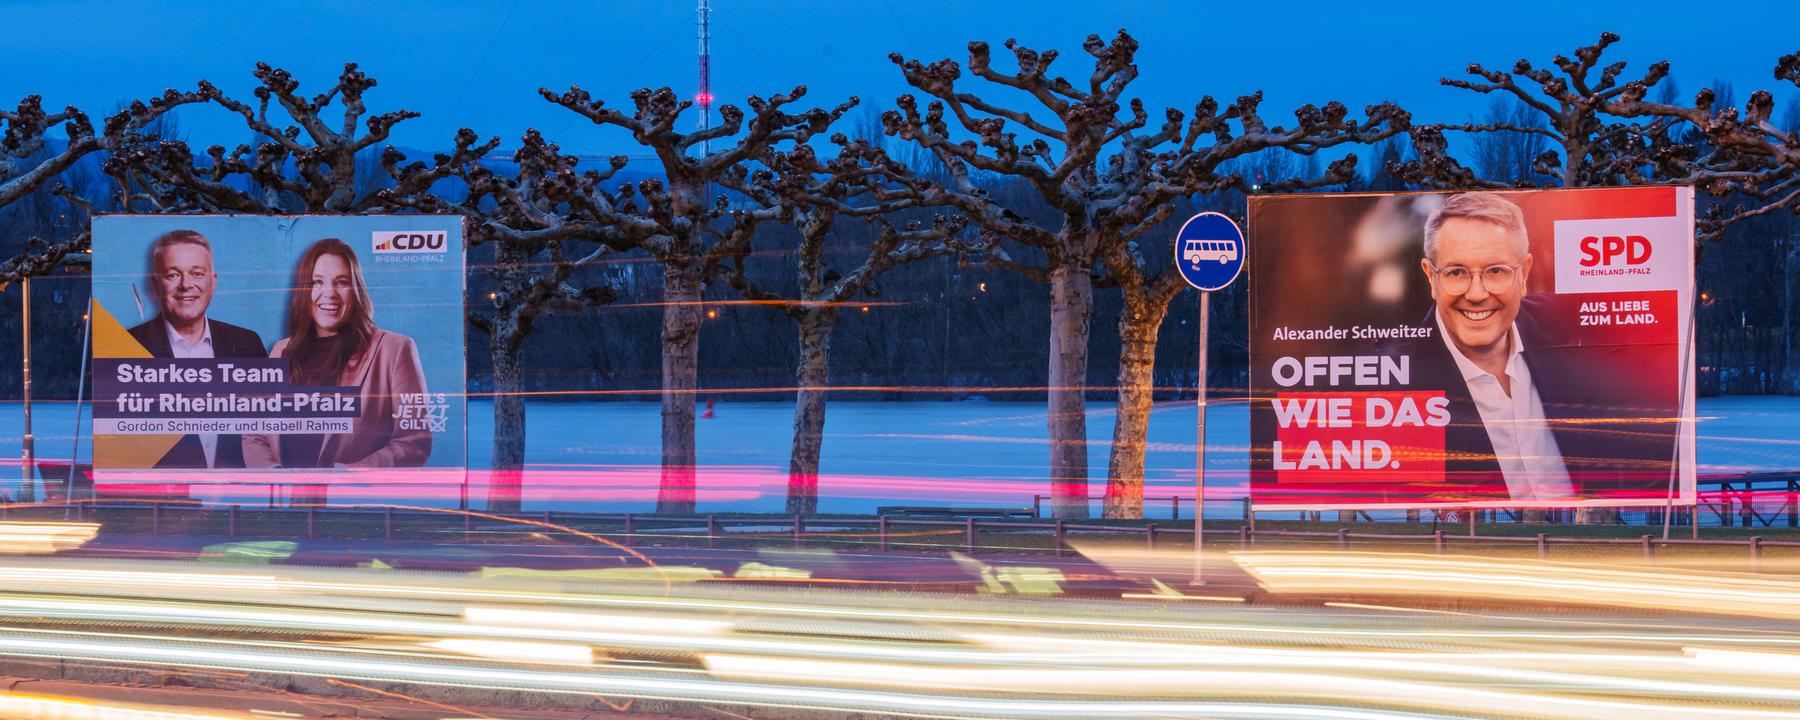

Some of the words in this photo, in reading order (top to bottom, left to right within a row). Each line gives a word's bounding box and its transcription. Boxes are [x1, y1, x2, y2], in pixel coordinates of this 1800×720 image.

[392, 234, 444, 249] CDU
[1579, 235, 1653, 267] SPD
[376, 255, 444, 263] RHEINLAND-PFALZ
[1580, 267, 1651, 276] RHEINLAND-PFALZ
[1579, 302, 1608, 313] AUS
[1611, 300, 1650, 312] LIEBE
[1580, 315, 1611, 326] ZUM
[1615, 314, 1658, 325] LAND.
[1273, 326, 1348, 341] Alexander
[1352, 324, 1433, 339] Schweitzer
[117, 363, 212, 383] Starkes
[218, 364, 284, 383] Team
[1272, 355, 1410, 387] OFFEN
[117, 392, 155, 412] für
[160, 392, 355, 412] Rheinland-Pfalz
[392, 404, 450, 419] JETZT
[1271, 397, 1353, 429] WIE
[1365, 396, 1451, 428] DAS
[117, 420, 165, 432] Gordon
[168, 420, 232, 432] Schnieder
[235, 420, 259, 432] und
[262, 420, 304, 432] Isabell
[307, 420, 348, 432] Rahms
[399, 418, 431, 430] GILT
[1273, 440, 1401, 471] LAND.
